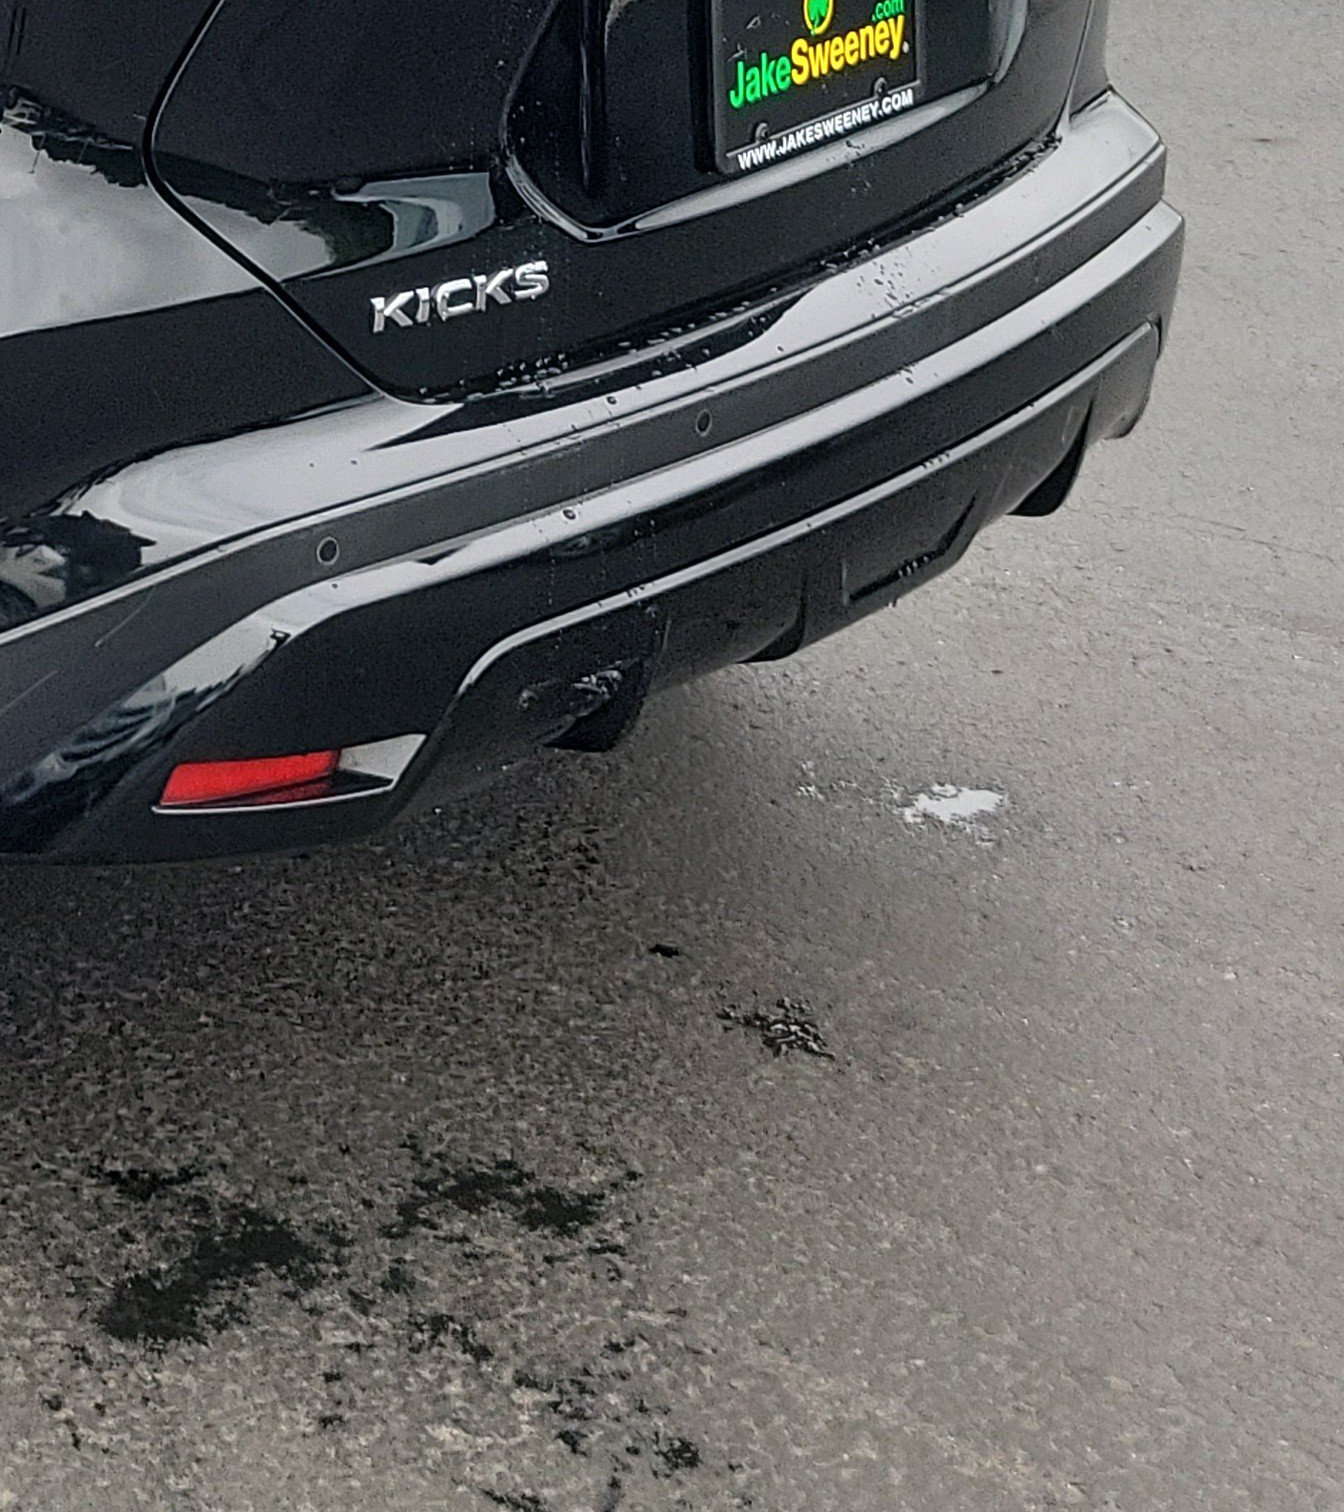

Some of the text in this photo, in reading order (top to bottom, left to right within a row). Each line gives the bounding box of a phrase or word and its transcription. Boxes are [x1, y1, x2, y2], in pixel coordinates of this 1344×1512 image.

[729, 15, 905, 109] JakeSweeney
[737, 89, 914, 170] WWW.JAKESWEENEY.COM
[370, 260, 550, 334] KICKS
